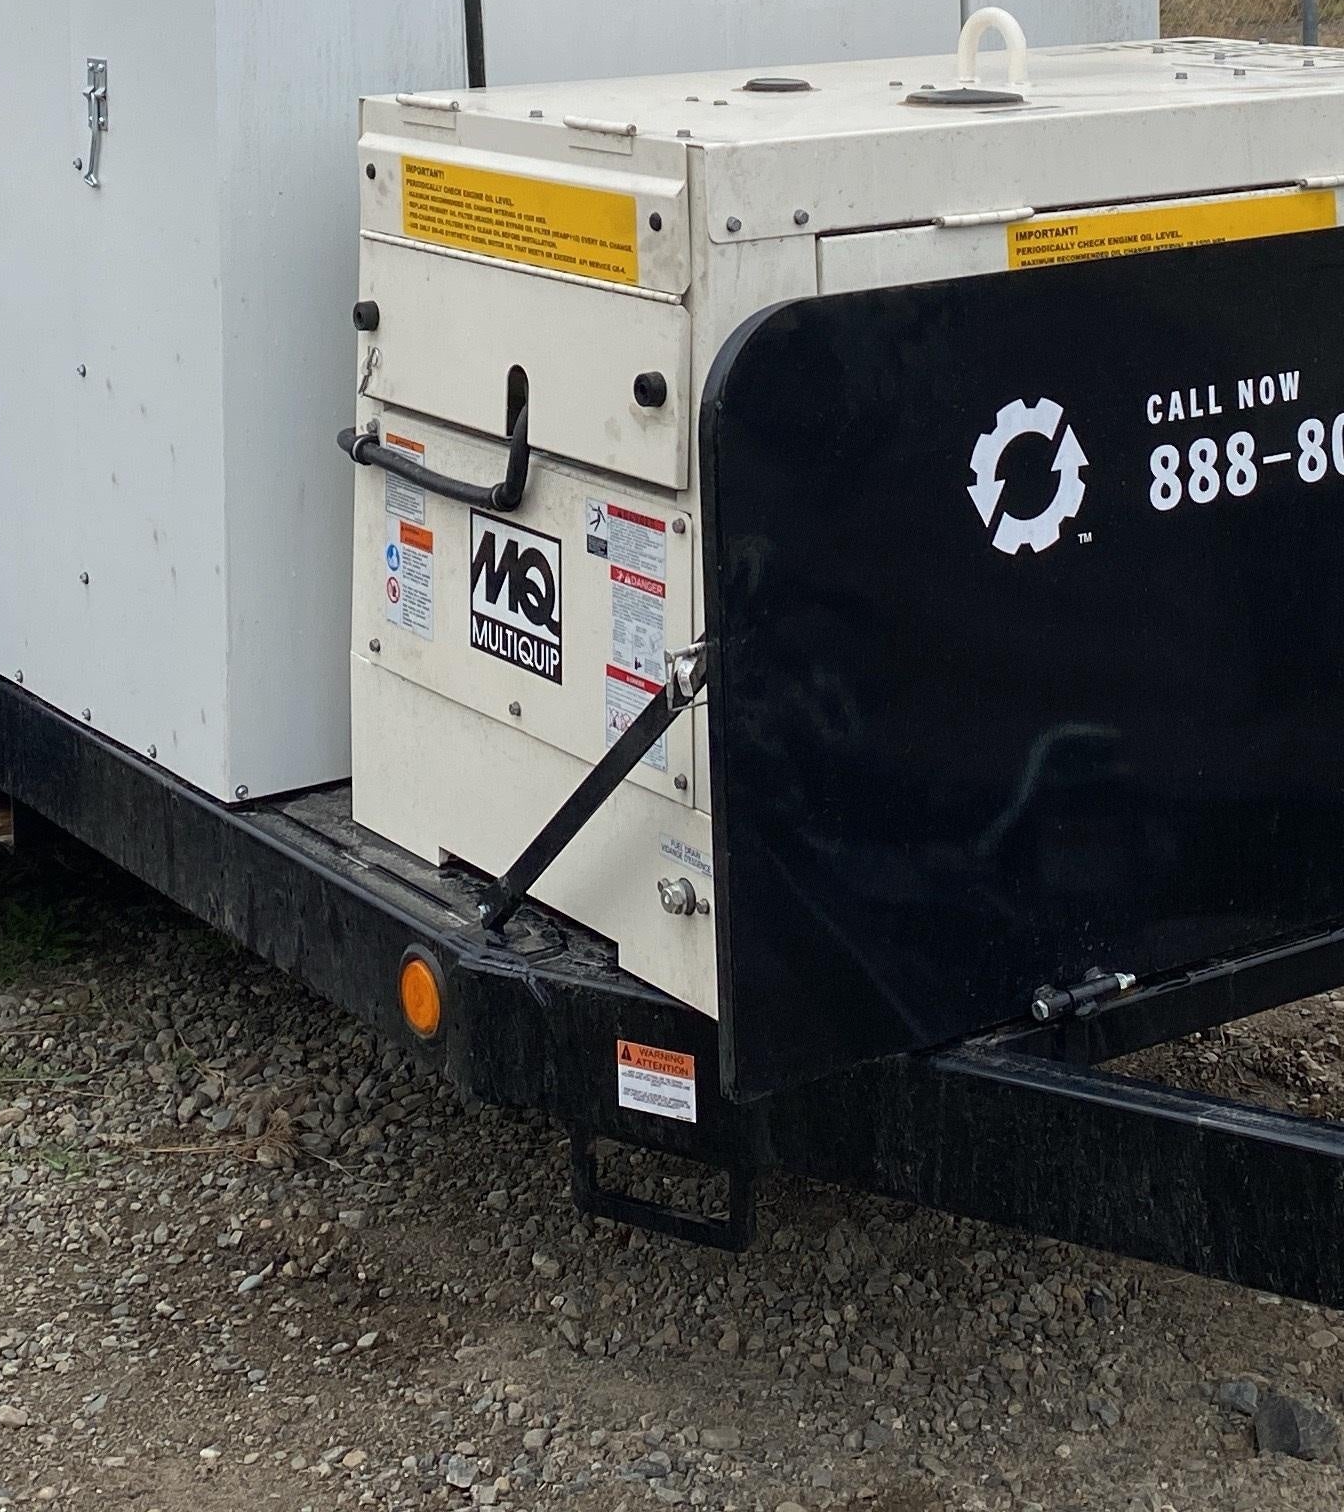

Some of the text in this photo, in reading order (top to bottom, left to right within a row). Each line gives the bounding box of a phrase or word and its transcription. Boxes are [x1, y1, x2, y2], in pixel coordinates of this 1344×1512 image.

[405, 163, 444, 180] IMPORTANT!
[443, 186, 461, 196] CHECK
[1015, 226, 1078, 241] IMPORTANT!
[1016, 230, 1183, 255] PERIODICALLY CHECK ENGINE OIL LEVEL.
[1147, 370, 1301, 425] CALL NOW
[472, 530, 561, 639] MQ
[632, 578, 664, 595] DANGER
[471, 614, 561, 677] MULTIQUIP
[639, 1046, 685, 1065] WARNING
[635, 1056, 689, 1076] ATTENTION
